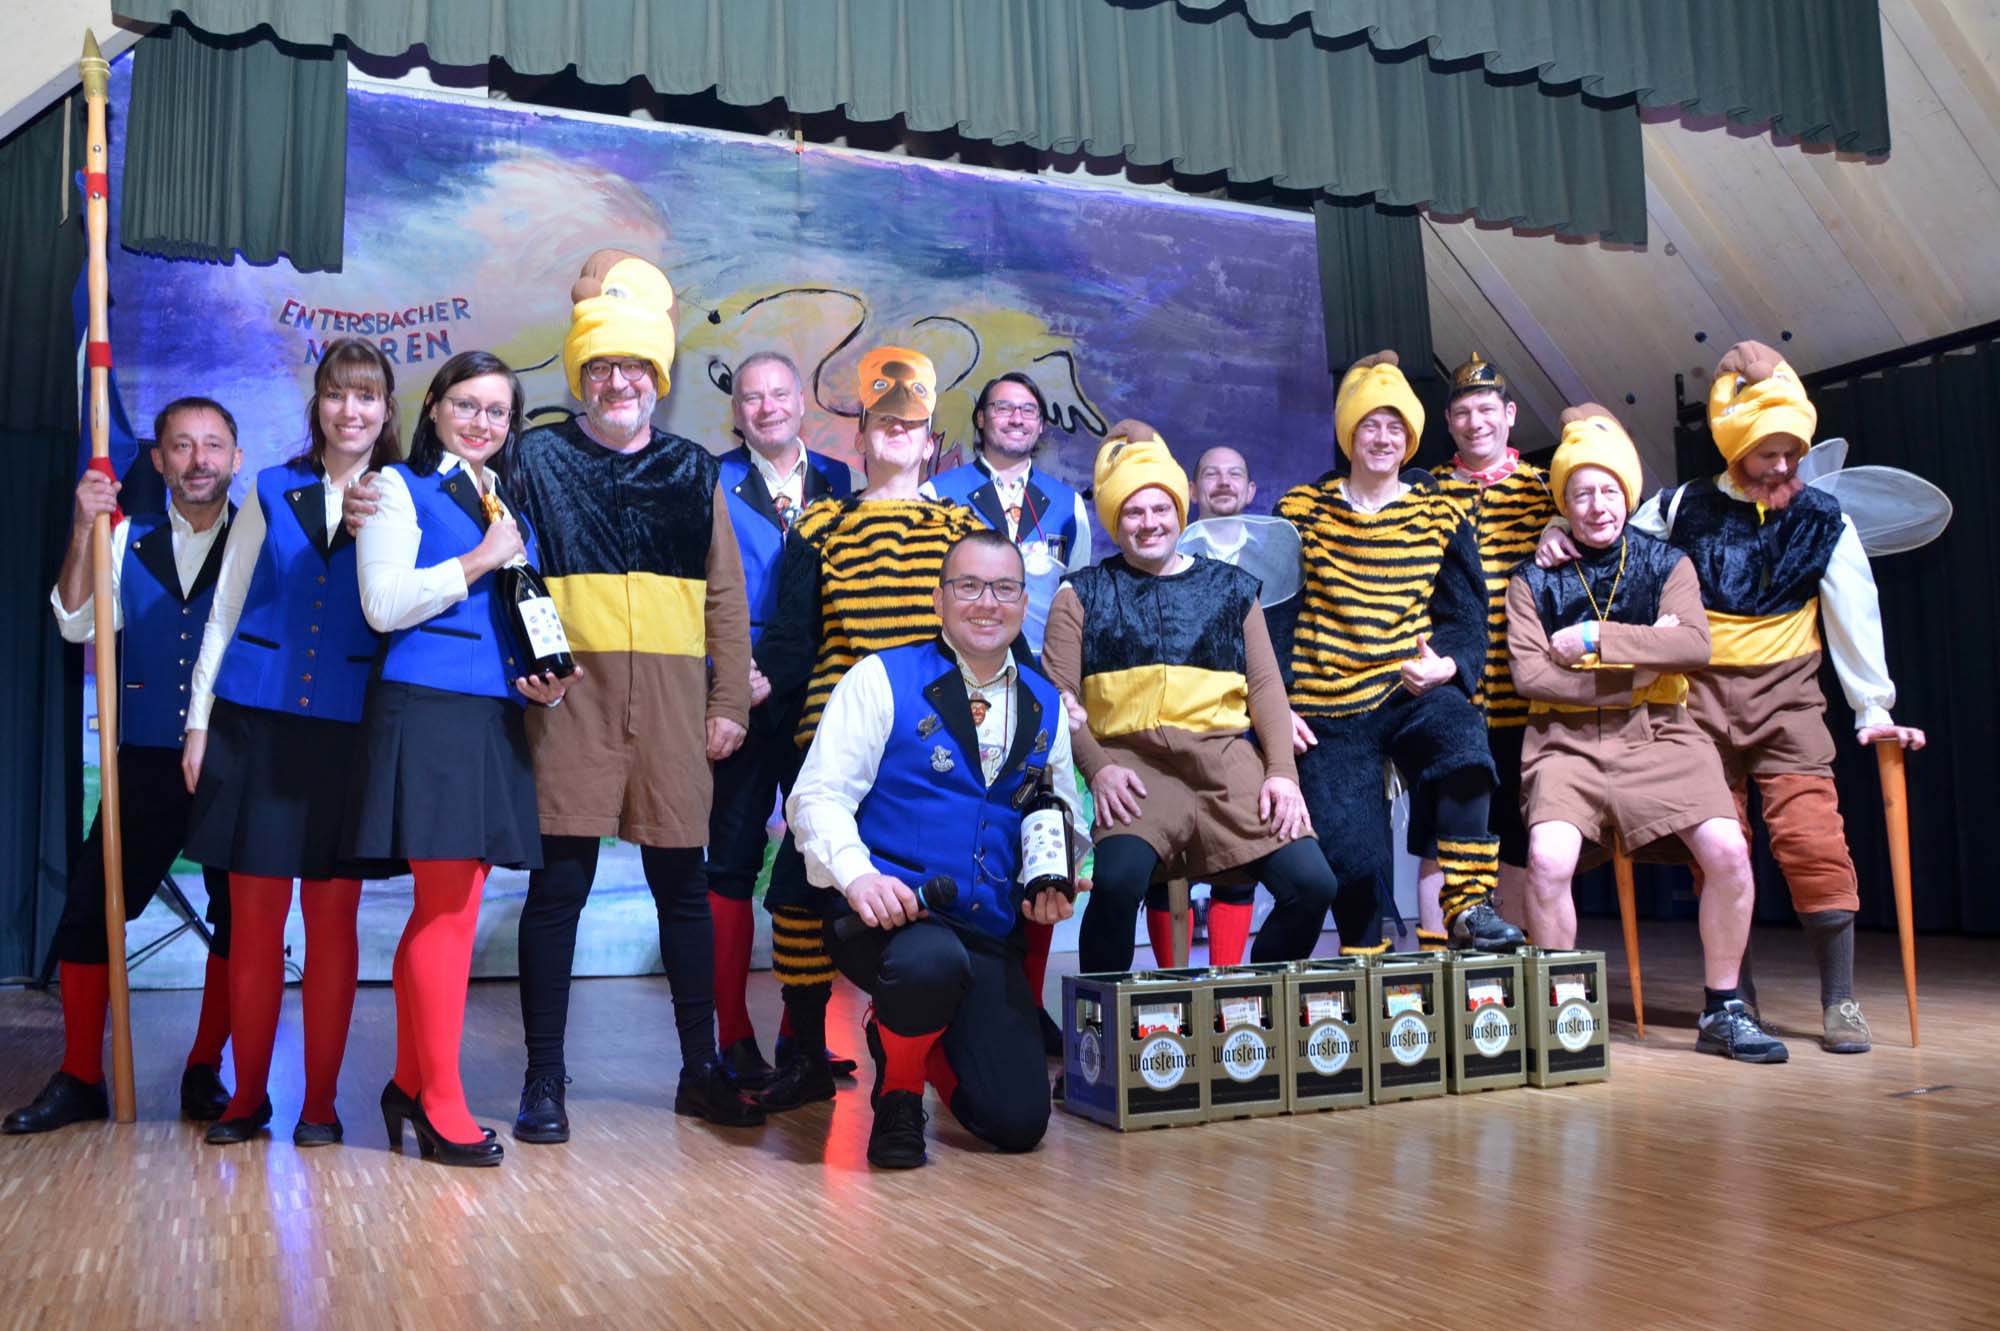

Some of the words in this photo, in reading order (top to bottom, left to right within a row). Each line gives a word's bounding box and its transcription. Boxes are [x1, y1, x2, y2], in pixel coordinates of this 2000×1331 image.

[279, 298, 471, 335] ENTERSBACHER
[304, 329, 453, 364] NREN
[1464, 1021, 1519, 1041] Warsteiner
[1548, 1016, 1602, 1035] Warsteiner
[1298, 1038, 1360, 1057] Warsteiner
[1381, 1030, 1438, 1049] Warsteiner
[1129, 1051, 1197, 1072] Warsteiner
[1212, 1044, 1277, 1064] Warsteiner
